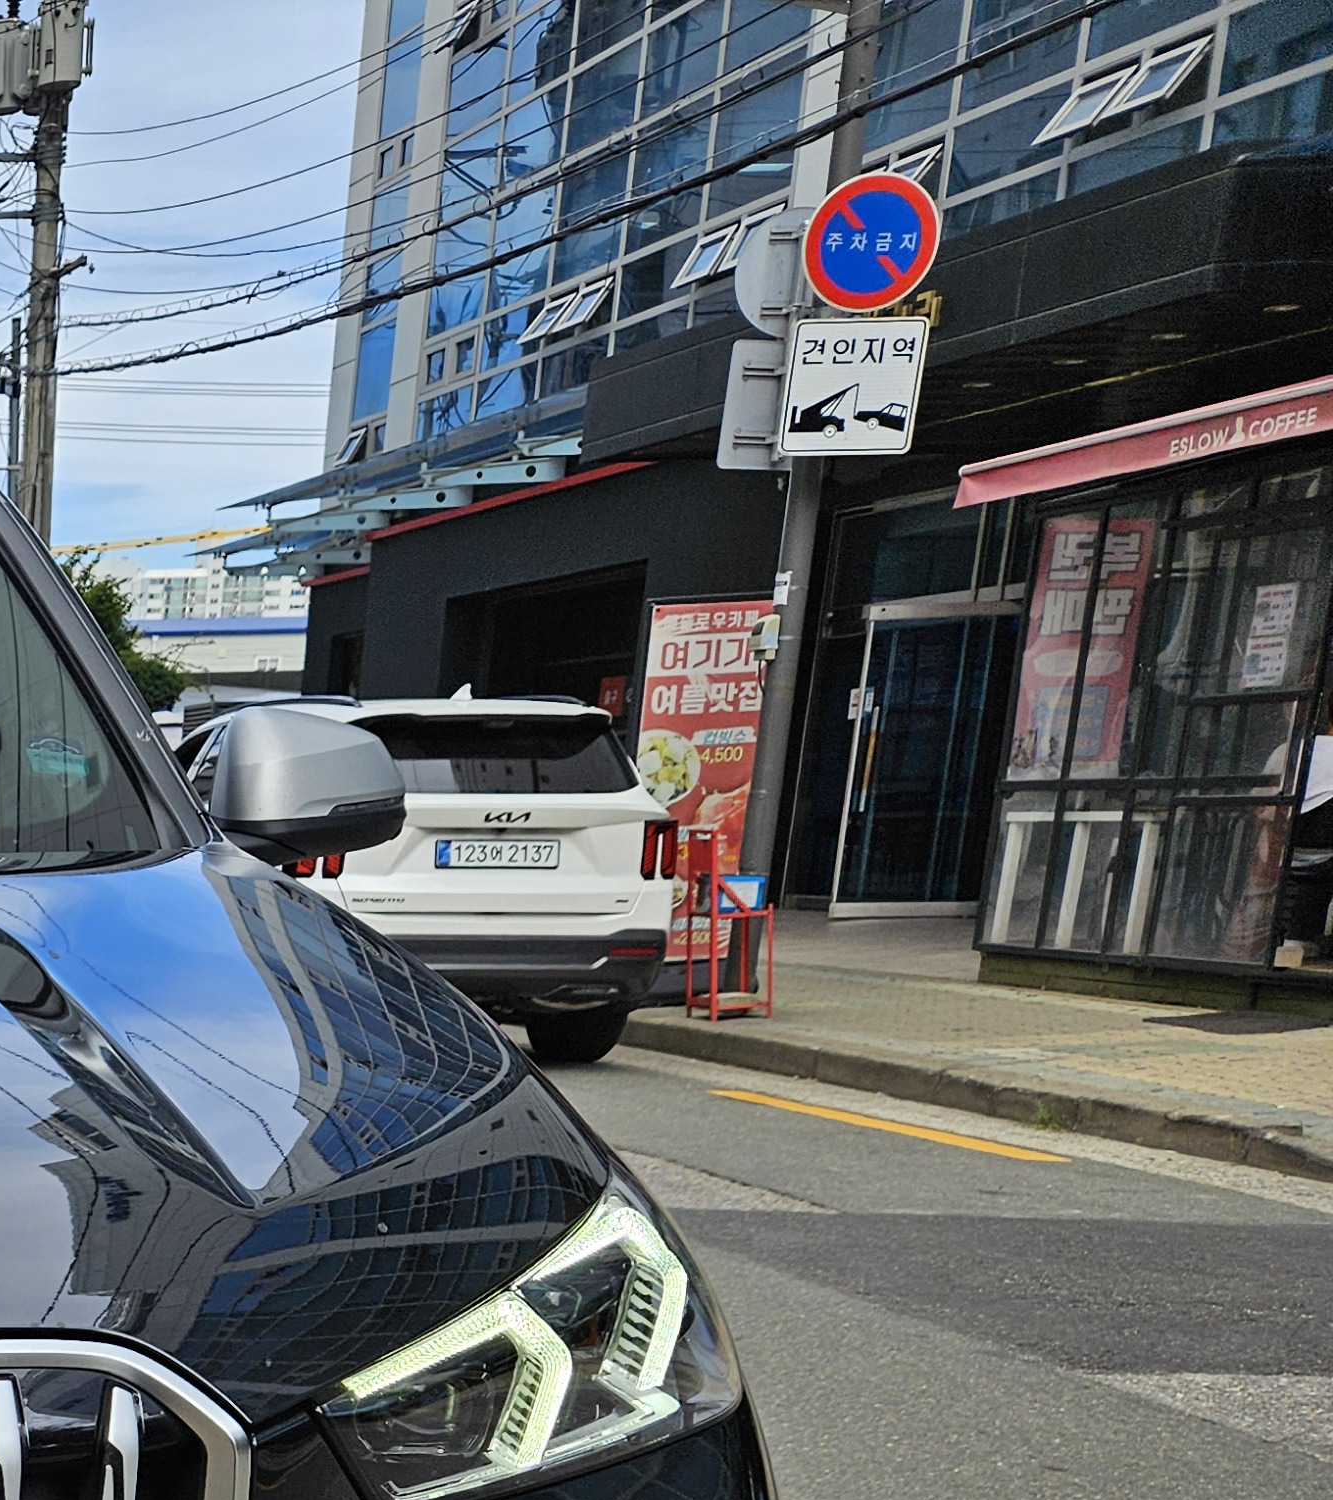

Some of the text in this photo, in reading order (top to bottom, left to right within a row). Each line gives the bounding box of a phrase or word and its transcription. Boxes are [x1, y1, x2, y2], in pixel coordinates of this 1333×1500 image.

[825, 230, 918, 253] 주차금지
[801, 335, 917, 366] 견인지역
[1168, 407, 1318, 458] ESLOW COFFEE
[651, 680, 762, 715] 여름맛집
[700, 745, 744, 765] 4,500
[482, 811, 532, 824] KIA
[454, 844, 555, 864] 123어 2137
